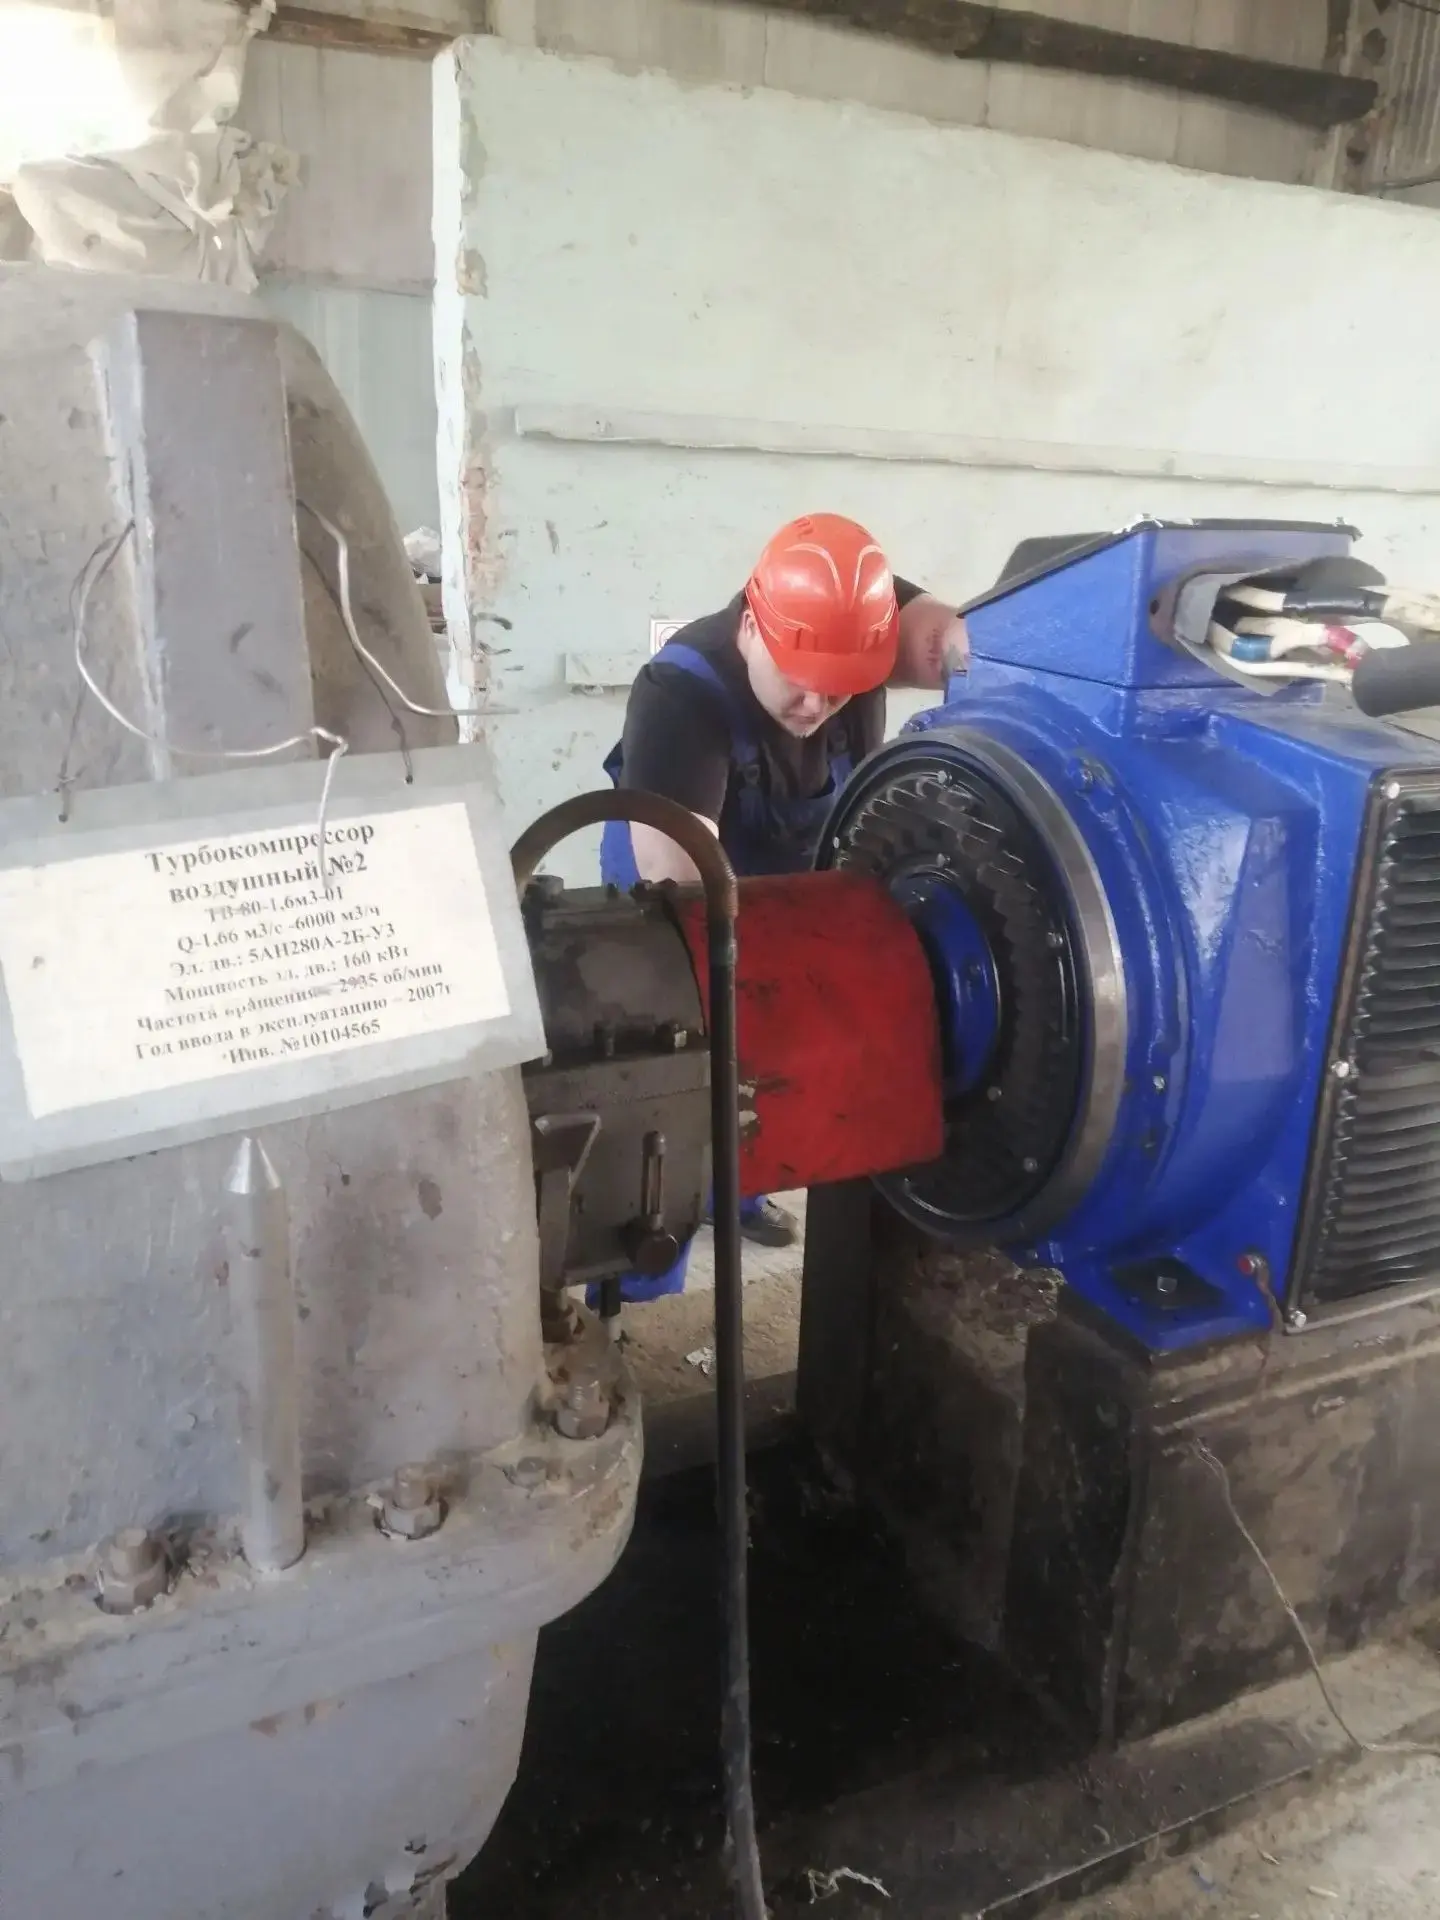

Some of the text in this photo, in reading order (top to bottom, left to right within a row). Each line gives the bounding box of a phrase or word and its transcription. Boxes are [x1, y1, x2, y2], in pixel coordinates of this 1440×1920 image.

[145, 824, 375, 876] Турбокомпрессор
[169, 850, 368, 905] воздушный №2
[137, 1006, 218, 1032] Частота
[383, 963, 443, 986] об/мин
[164, 975, 269, 1003] Мощность
[343, 951, 371, 970] 160
[376, 945, 409, 963] кВт
[135, 1042, 174, 1060] Год
[178, 1030, 234, 1051] ввода
[258, 998, 388, 1035] эксплуатацию
